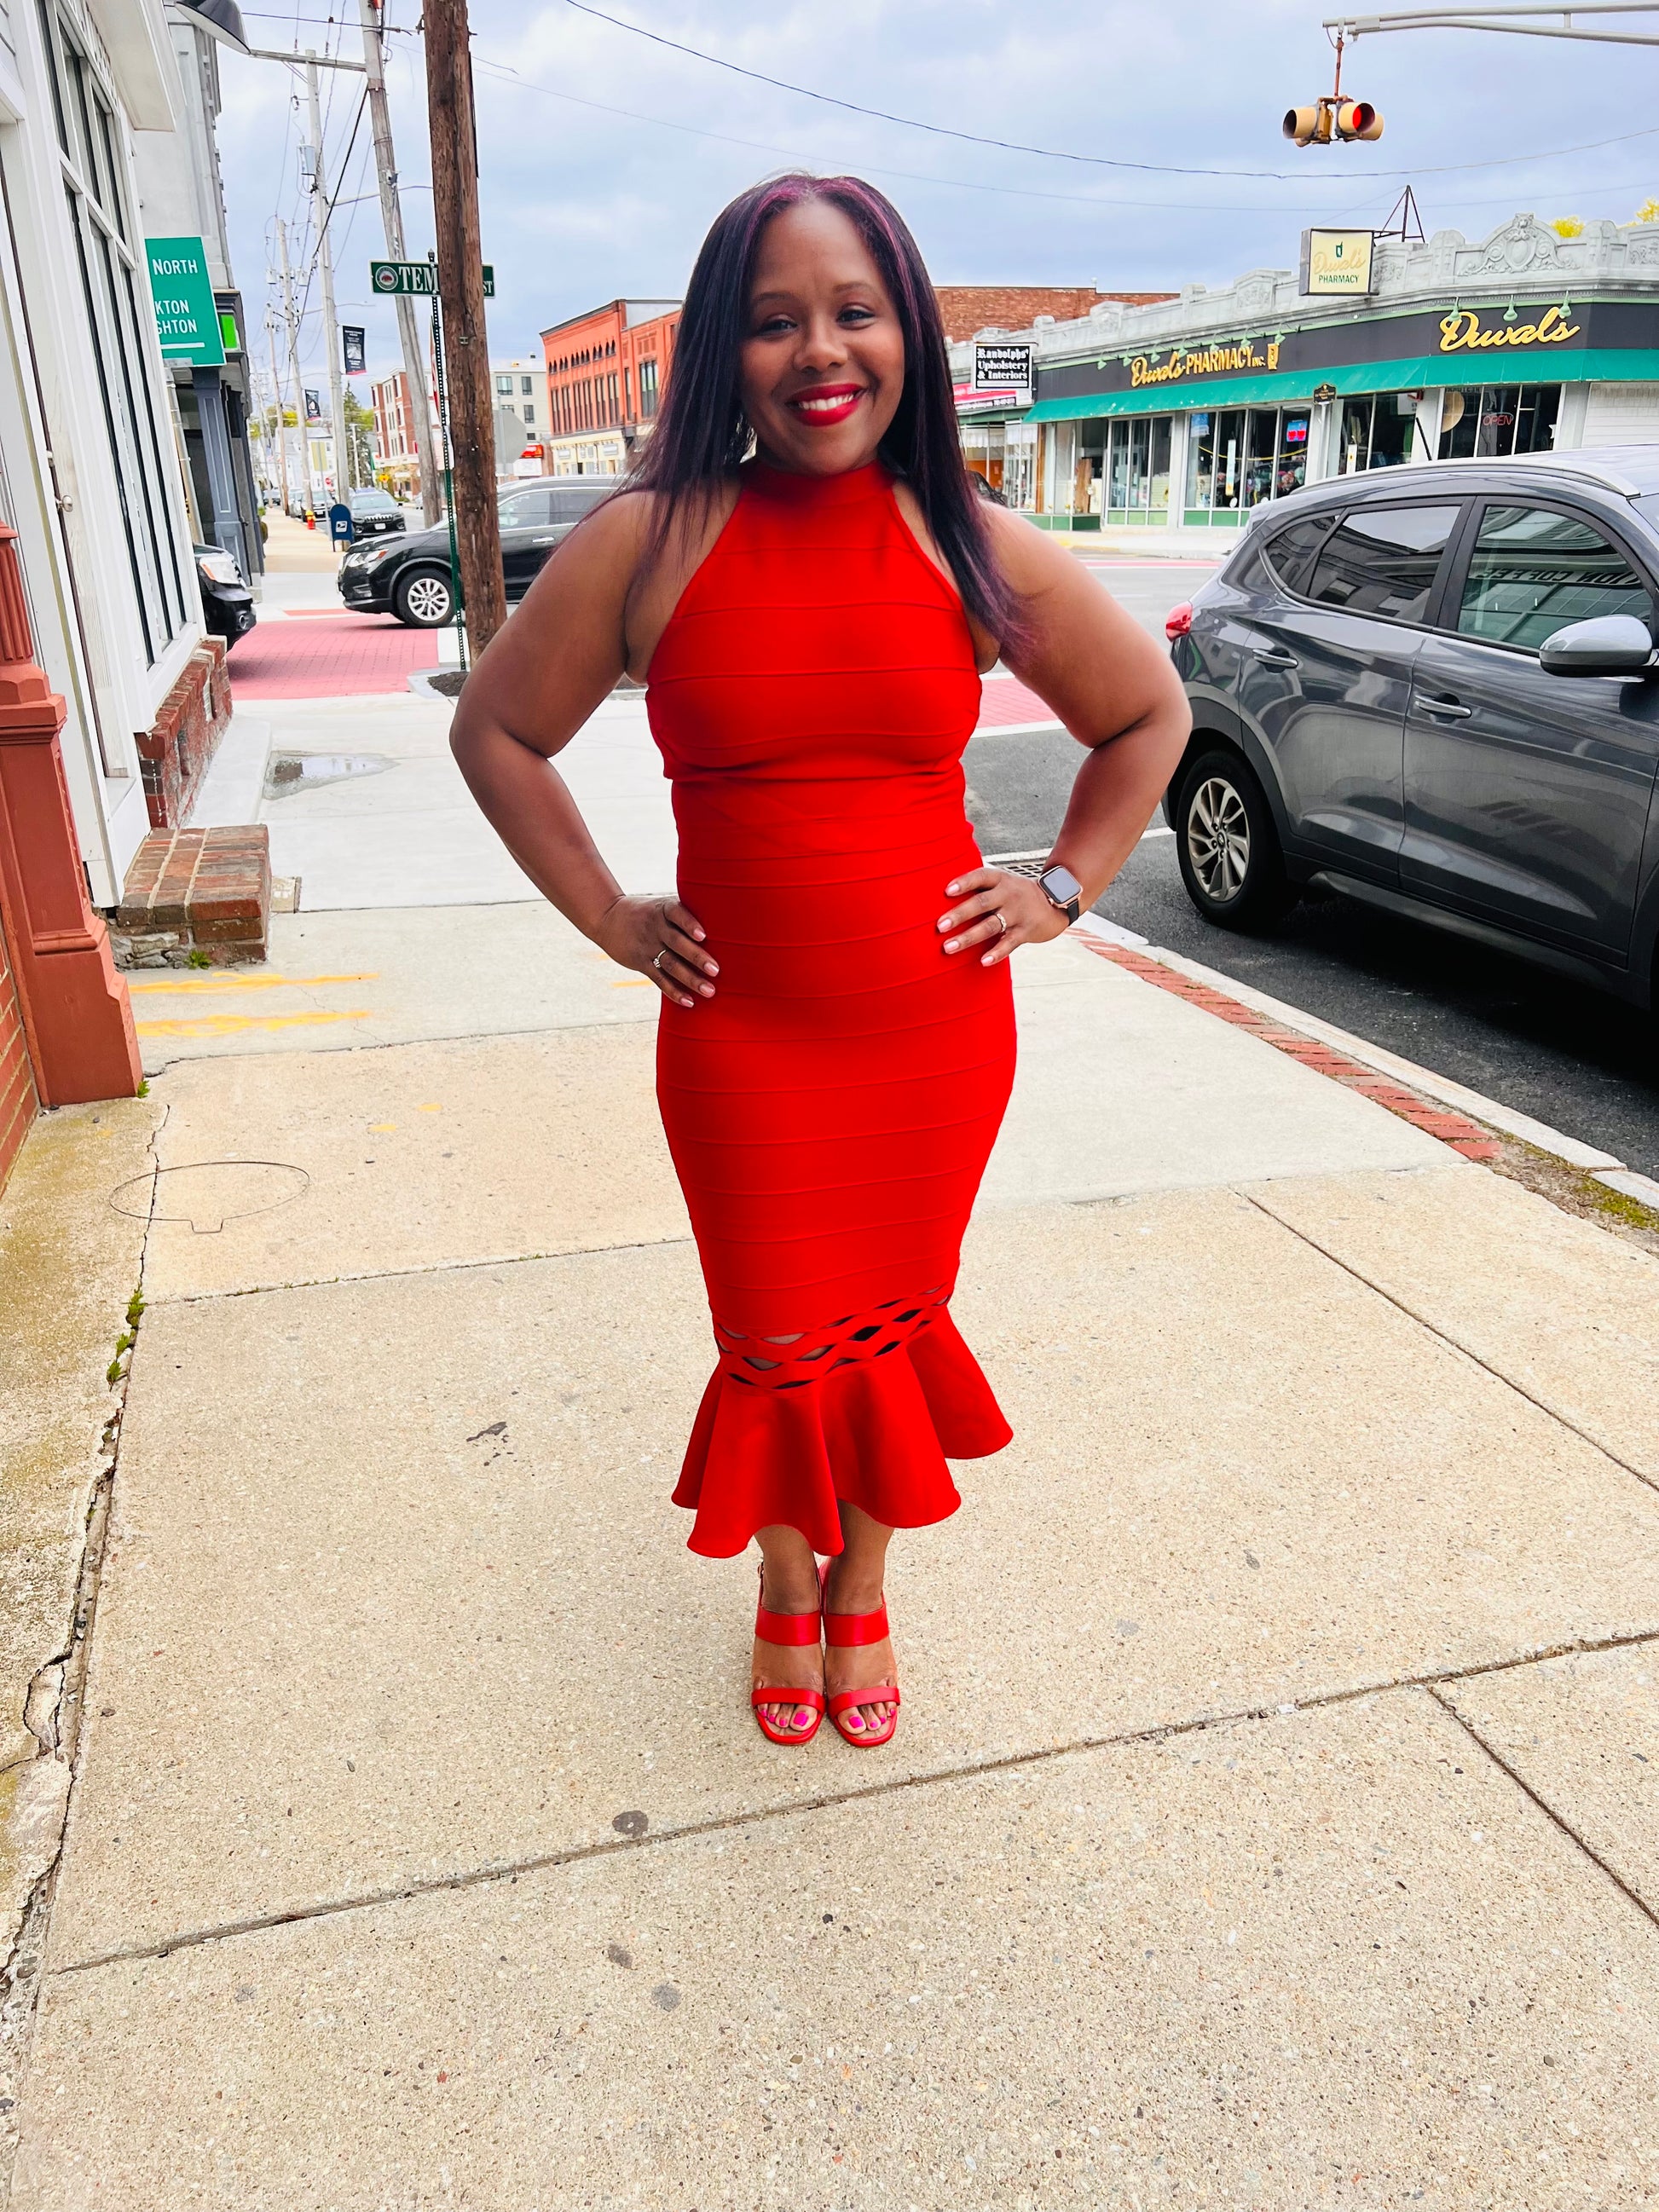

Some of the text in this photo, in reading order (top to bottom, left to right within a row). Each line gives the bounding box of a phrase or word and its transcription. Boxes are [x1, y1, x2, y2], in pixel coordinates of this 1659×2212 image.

[152, 259, 198, 275] NORTH
[398, 266, 440, 292] TEM
[1318, 274, 1359, 284] PHARMACY
[154, 300, 189, 315] KTON
[157, 319, 197, 335] GHTON
[1439, 306, 1580, 351] Duvals
[977, 360, 1028, 372] Upholstery
[1186, 345, 1254, 374] PHARMACY
[977, 371, 1027, 379] & Interiors
[1483, 415, 1512, 425] OPEN
